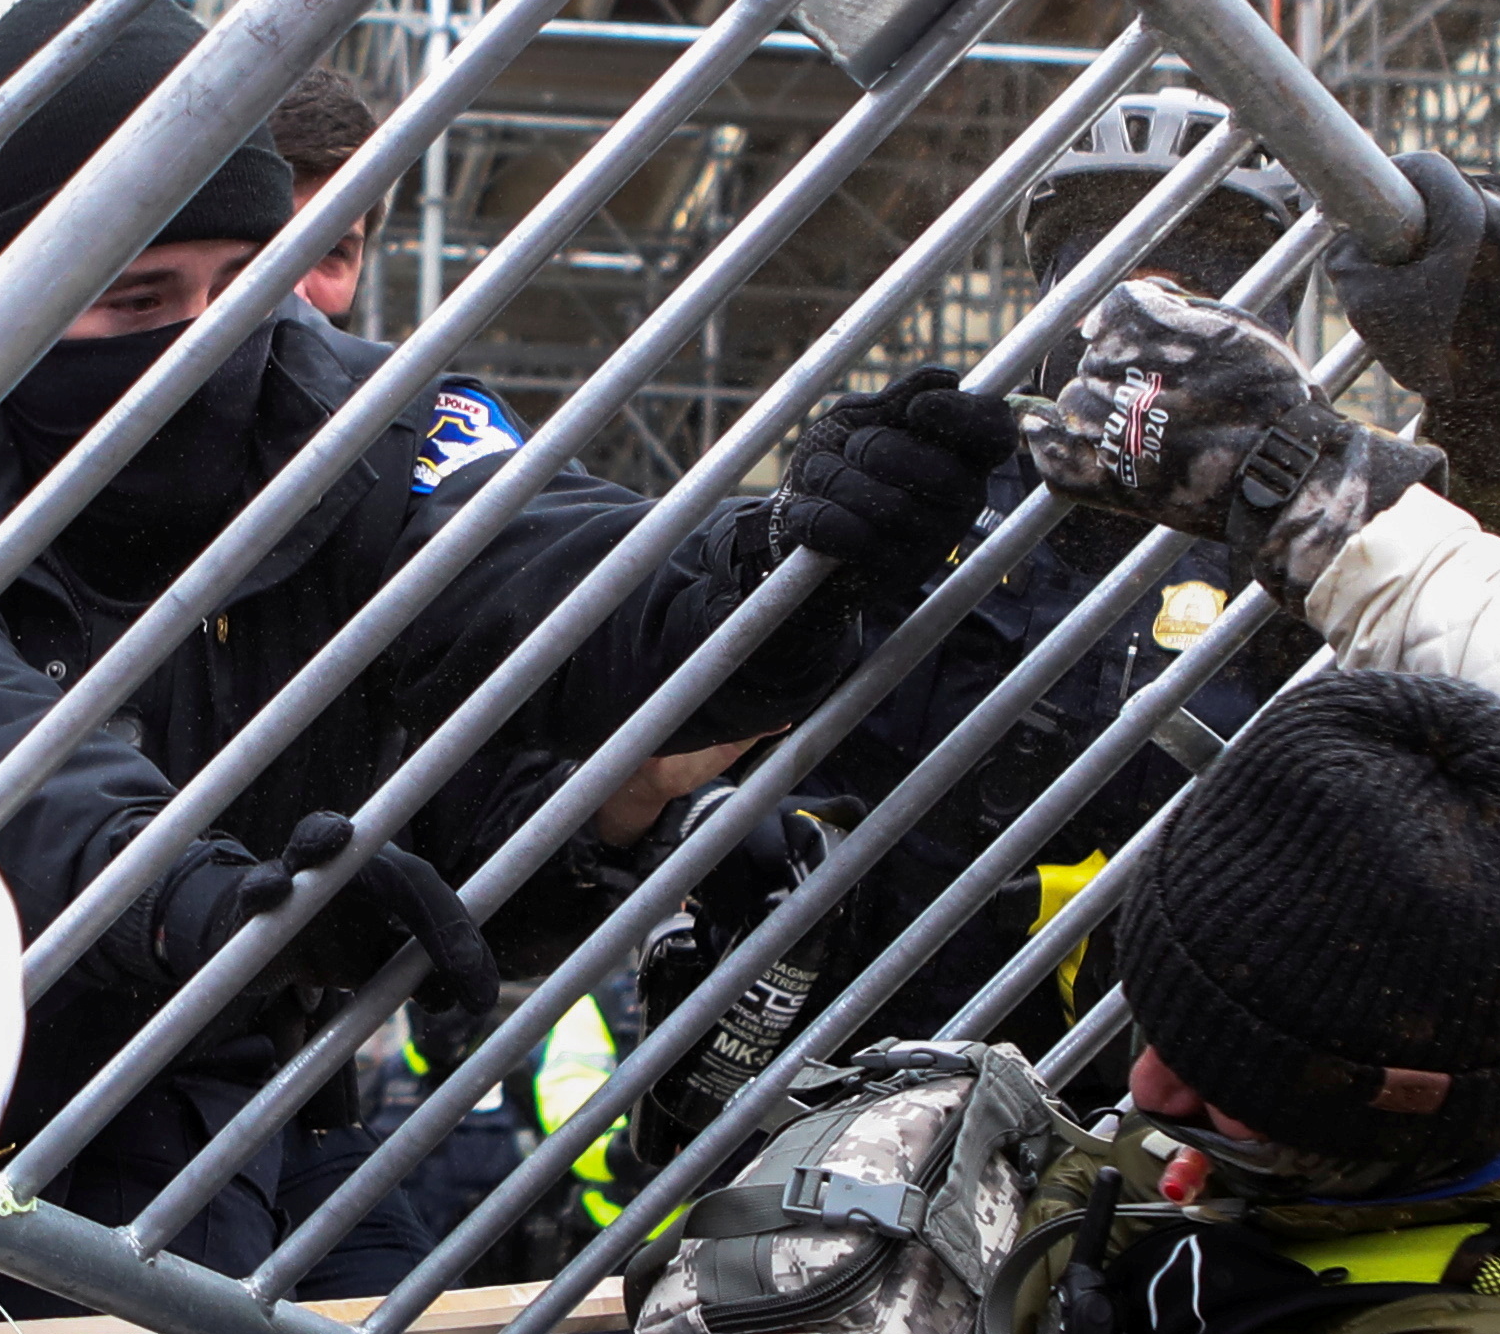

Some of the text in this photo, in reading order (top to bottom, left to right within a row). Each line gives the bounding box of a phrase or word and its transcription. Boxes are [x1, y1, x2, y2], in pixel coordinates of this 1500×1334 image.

[445, 397, 482, 415] POLICE
[1094, 367, 1151, 475] Trump
[1142, 408, 1169, 464] 2020
[713, 1031, 774, 1066] MK-9
